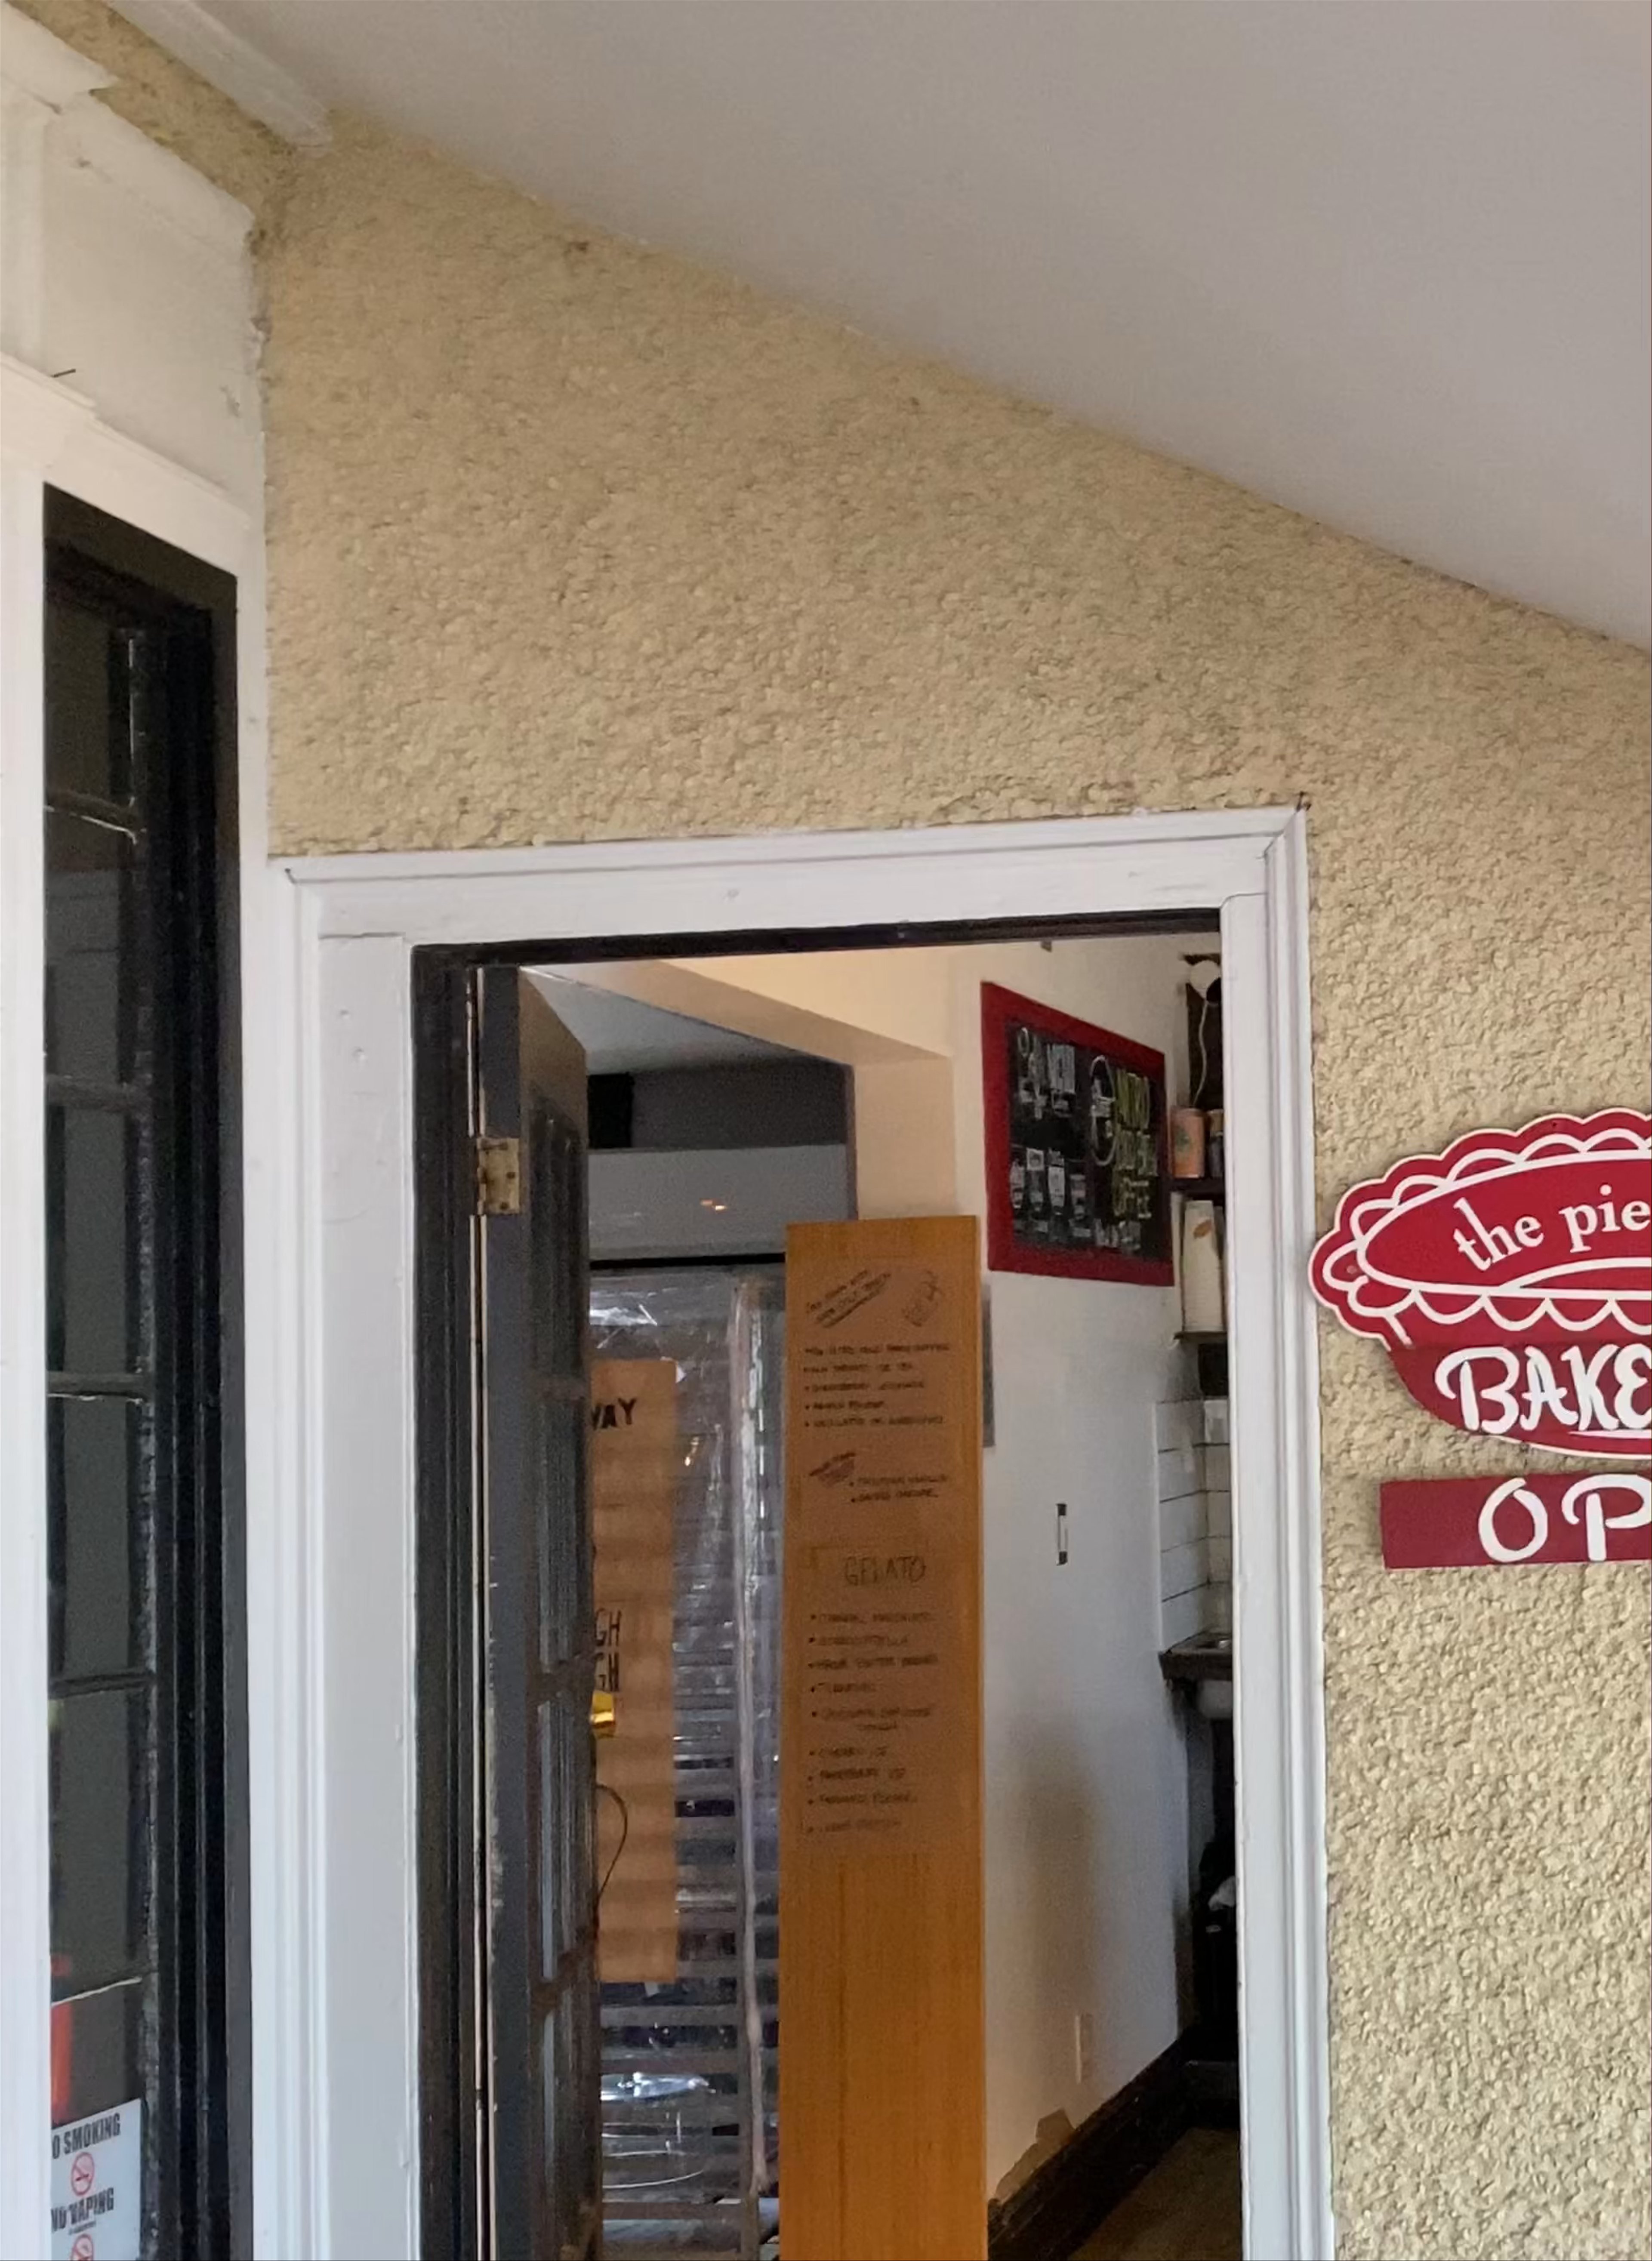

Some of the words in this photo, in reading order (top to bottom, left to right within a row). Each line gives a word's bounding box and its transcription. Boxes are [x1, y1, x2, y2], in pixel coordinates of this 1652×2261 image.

[1453, 1197, 1544, 1271] the
[1558, 1184, 1650, 1253] pie
[1434, 1343, 1652, 1435] BAKE
[1478, 1474, 1652, 1563] OP
[845, 1556, 926, 1586] GELATO
[64, 2113, 120, 2155] SMOKING
[69, 2187, 114, 2225] VAPING
